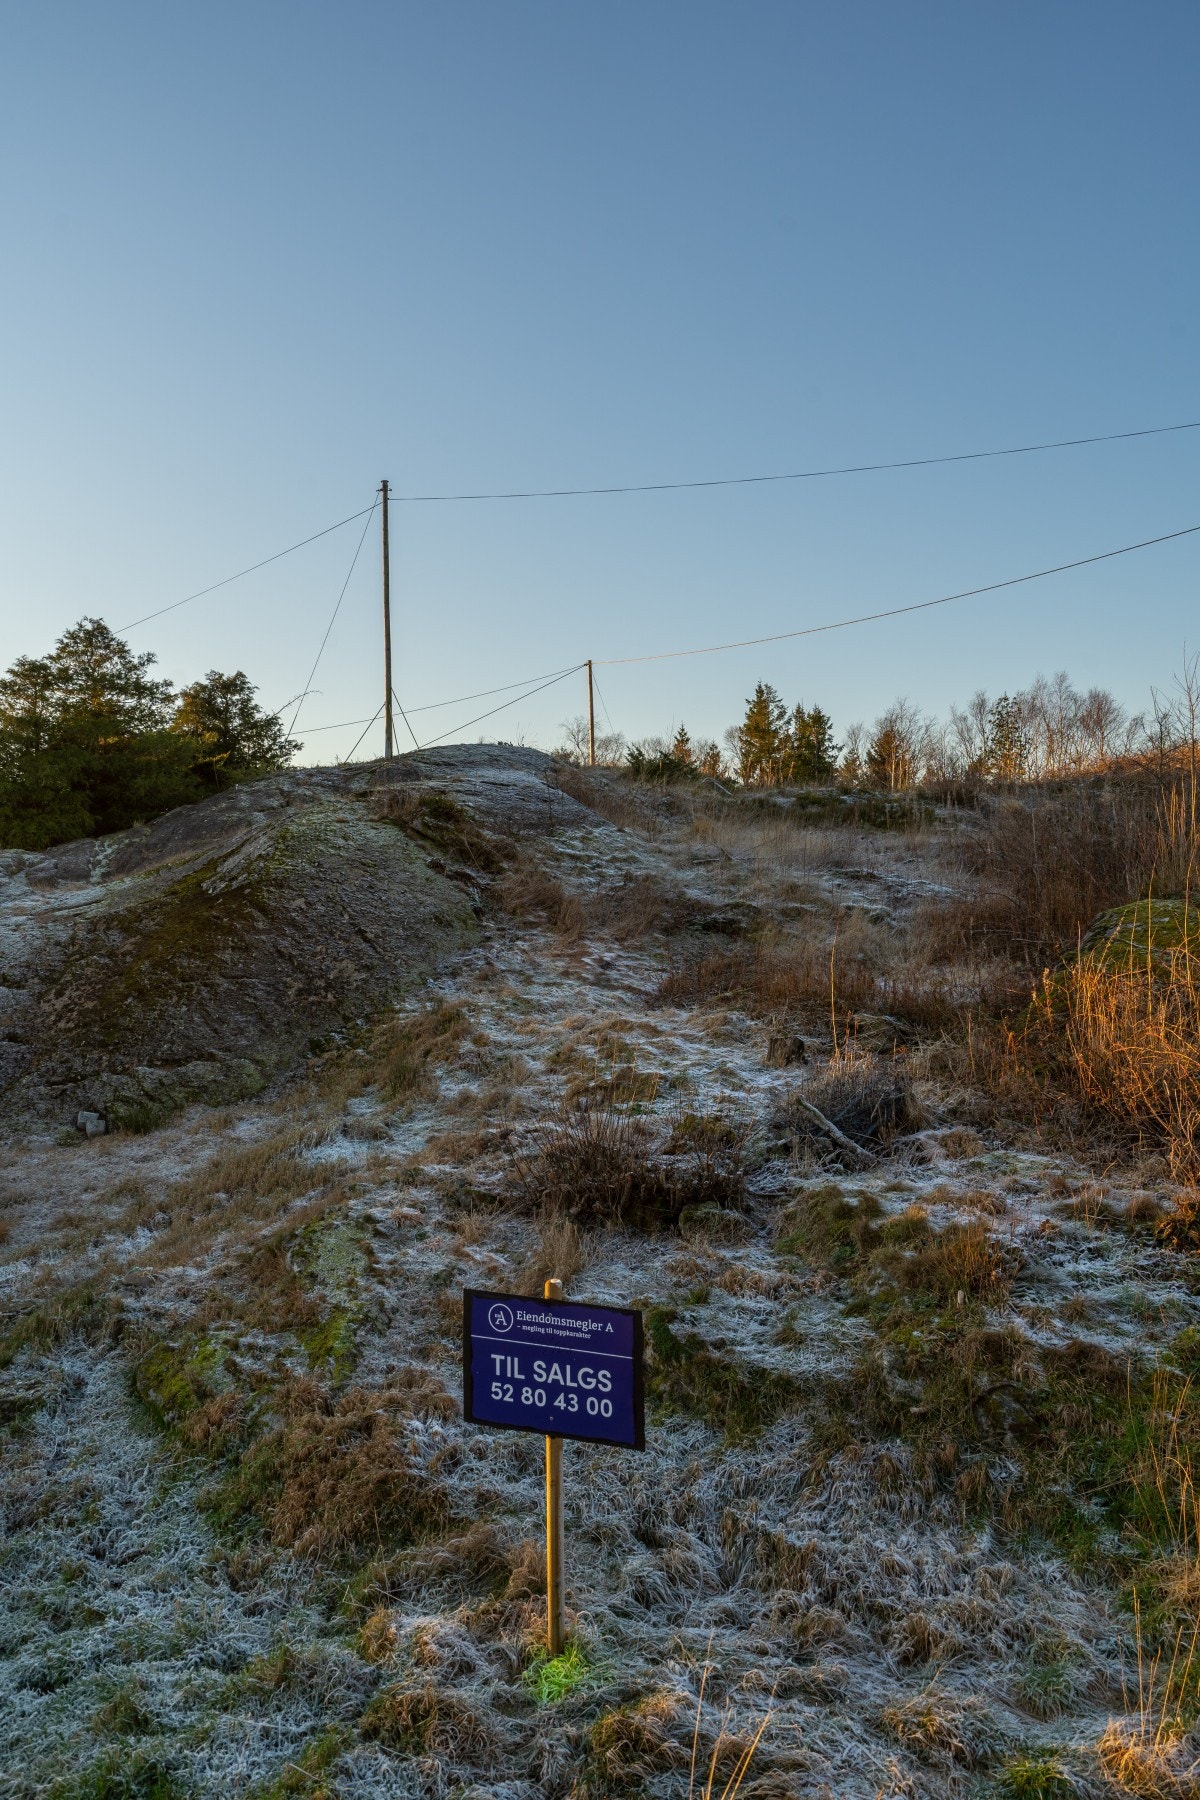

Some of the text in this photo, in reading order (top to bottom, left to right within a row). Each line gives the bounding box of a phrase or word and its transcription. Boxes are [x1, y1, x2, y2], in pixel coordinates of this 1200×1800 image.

[516, 1310, 614, 1333] Eiendomsmegler A
[522, 1325, 546, 1334] megling
[553, 1329, 592, 1339] toppkarakter
[490, 1353, 612, 1392] TIL SALGS
[491, 1381, 613, 1418] 52 80 43 00
